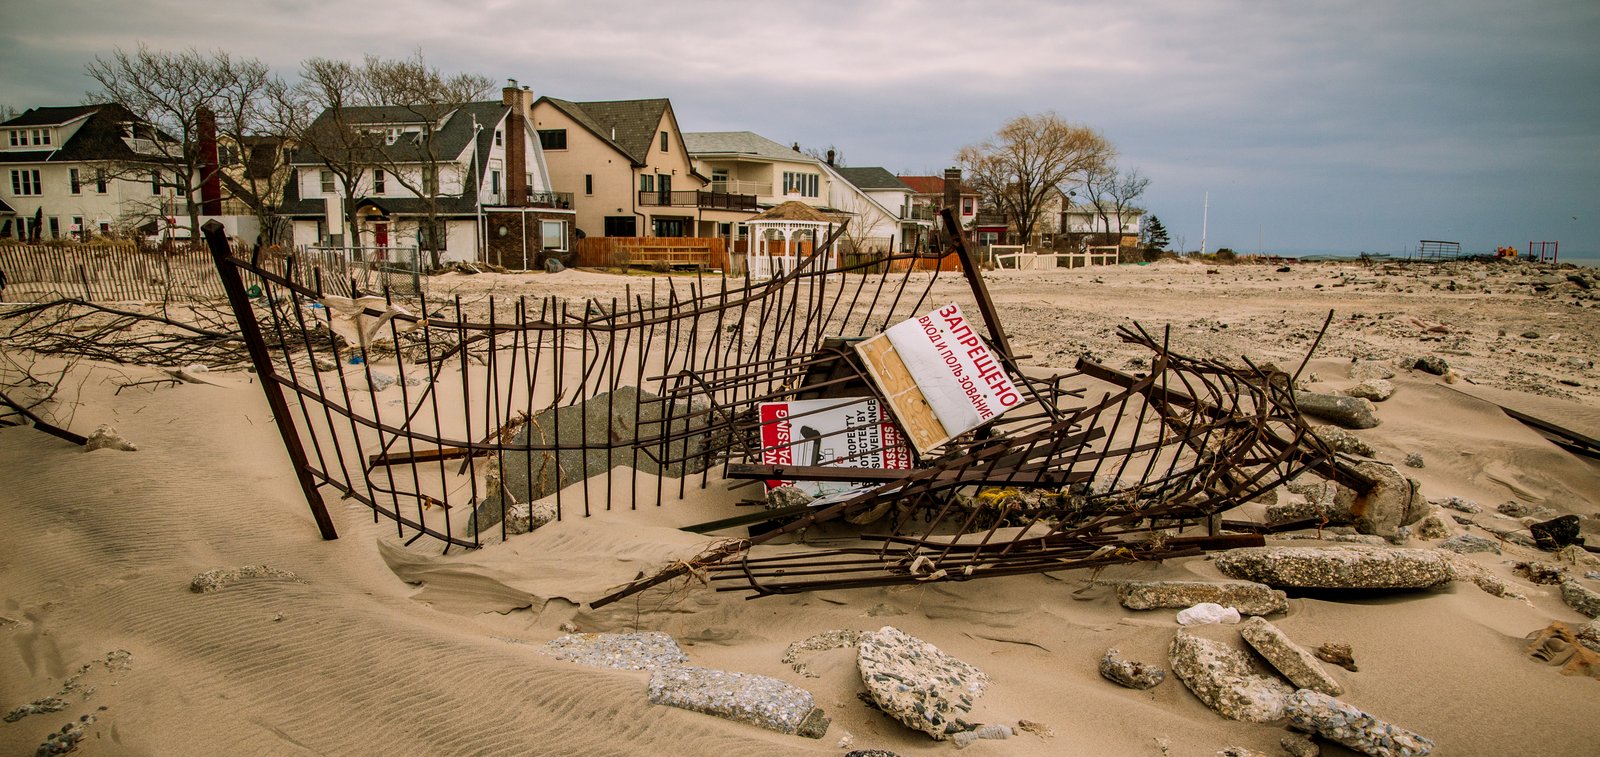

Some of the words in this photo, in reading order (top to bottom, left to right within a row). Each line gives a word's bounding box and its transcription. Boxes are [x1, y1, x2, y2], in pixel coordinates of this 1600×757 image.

[918, 315, 943, 344] ВХОД
[935, 341, 948, 352] И
[939, 305, 1019, 407] ЗАПРЕЩЕНО
[940, 348, 994, 420] ПОЛЬЗОВАНИЕ
[856, 410, 866, 422] BY
[765, 445, 777, 465] NO
